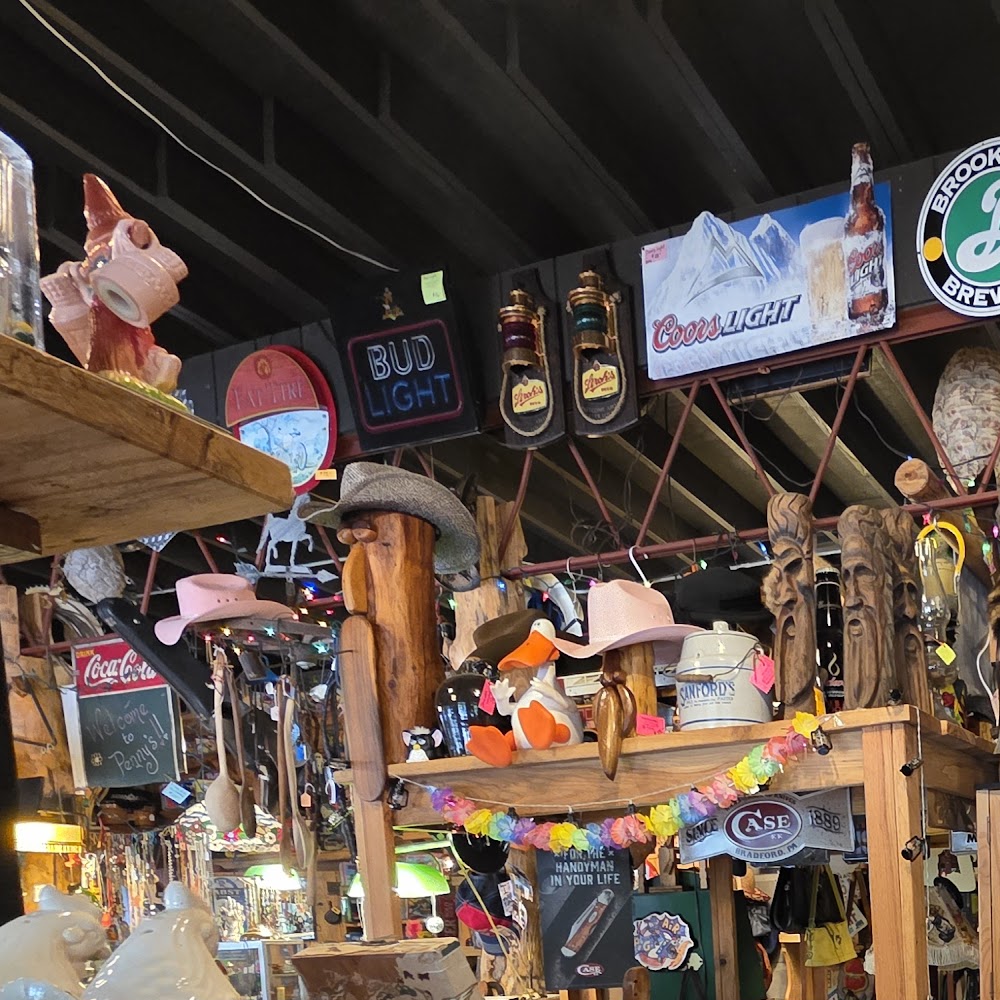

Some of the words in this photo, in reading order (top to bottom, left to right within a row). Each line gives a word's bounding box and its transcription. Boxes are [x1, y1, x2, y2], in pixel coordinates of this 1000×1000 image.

[652, 313, 722, 353] Coors
[721, 294, 802, 336] LIGHT
[367, 335, 436, 381] BUD
[365, 373, 451, 418] LIGHT
[86, 703, 149, 742] Welcome
[122, 732, 135, 745] to
[731, 809, 792, 840] CASE
[808, 810, 841, 831] 1889
[556, 861, 615, 873] HANDYMAN
[564, 849, 582, 861] FOR
[551, 875, 562, 886] IN
[566, 874, 593, 885] YOUR
[597, 873, 620, 885] LIFE
